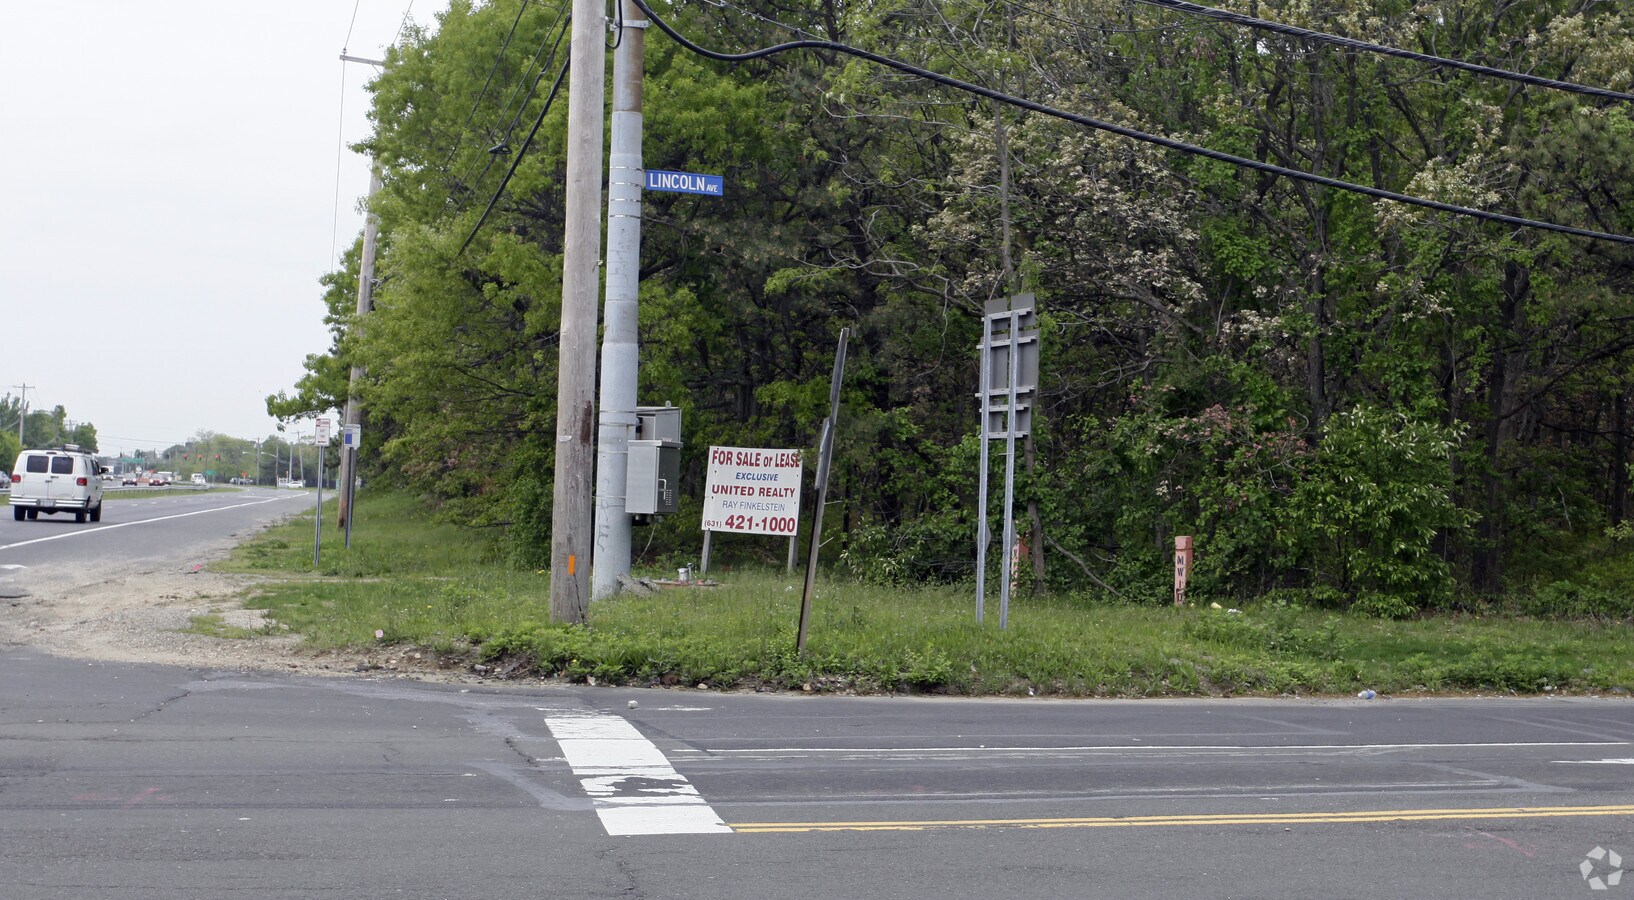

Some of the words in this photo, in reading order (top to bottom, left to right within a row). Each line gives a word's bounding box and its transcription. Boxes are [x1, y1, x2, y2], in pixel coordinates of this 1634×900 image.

[650, 173, 705, 191] LINCOLN
[706, 184, 718, 192] AVE
[712, 450, 733, 466] FOR
[735, 451, 761, 467] SALE
[763, 455, 773, 467] or
[774, 453, 800, 468] LEASE
[735, 472, 778, 481] EXCLUSIVE
[711, 484, 755, 496] UNITED
[758, 487, 796, 498] REALTY
[722, 500, 738, 509] RAY
[740, 501, 785, 511] FINKELSTEIN
[704, 520, 722, 528] (631)
